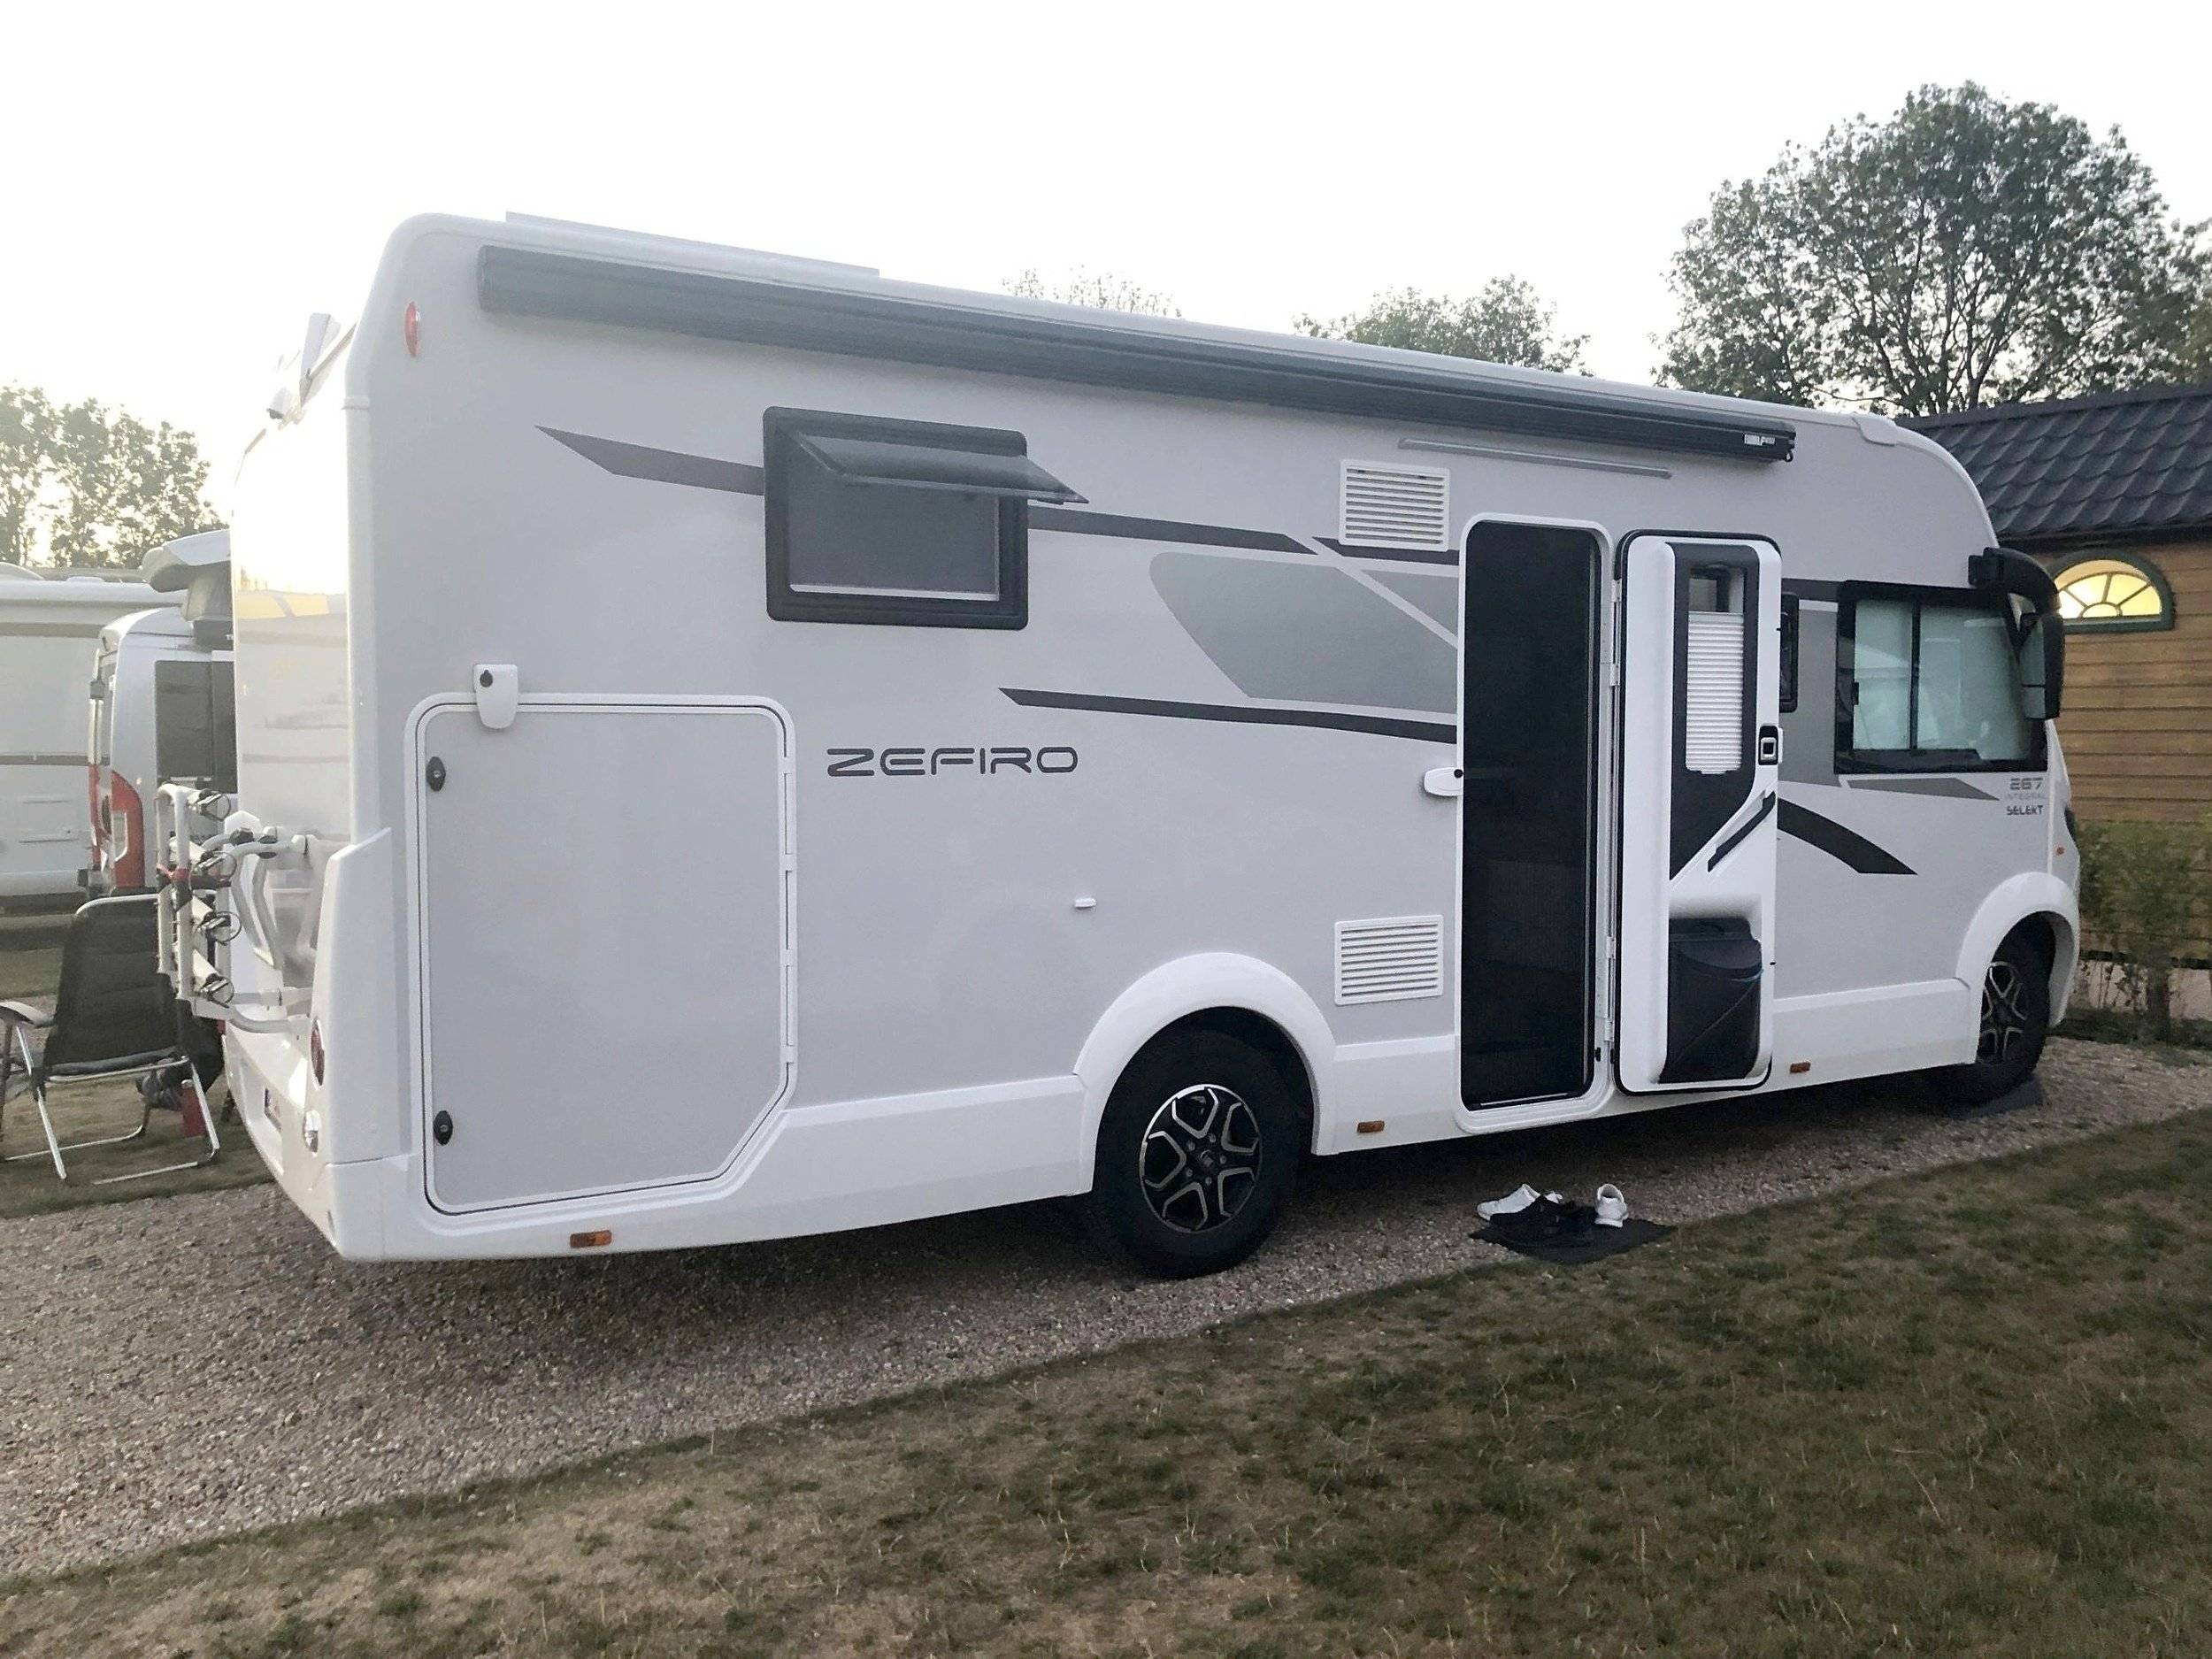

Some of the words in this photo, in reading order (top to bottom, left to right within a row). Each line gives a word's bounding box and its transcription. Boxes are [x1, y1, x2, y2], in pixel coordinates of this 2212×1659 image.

[826, 747, 1079, 777] ZEFIRO
[2009, 778, 2044, 790] 267
[2006, 804, 2044, 816] SELEKT
